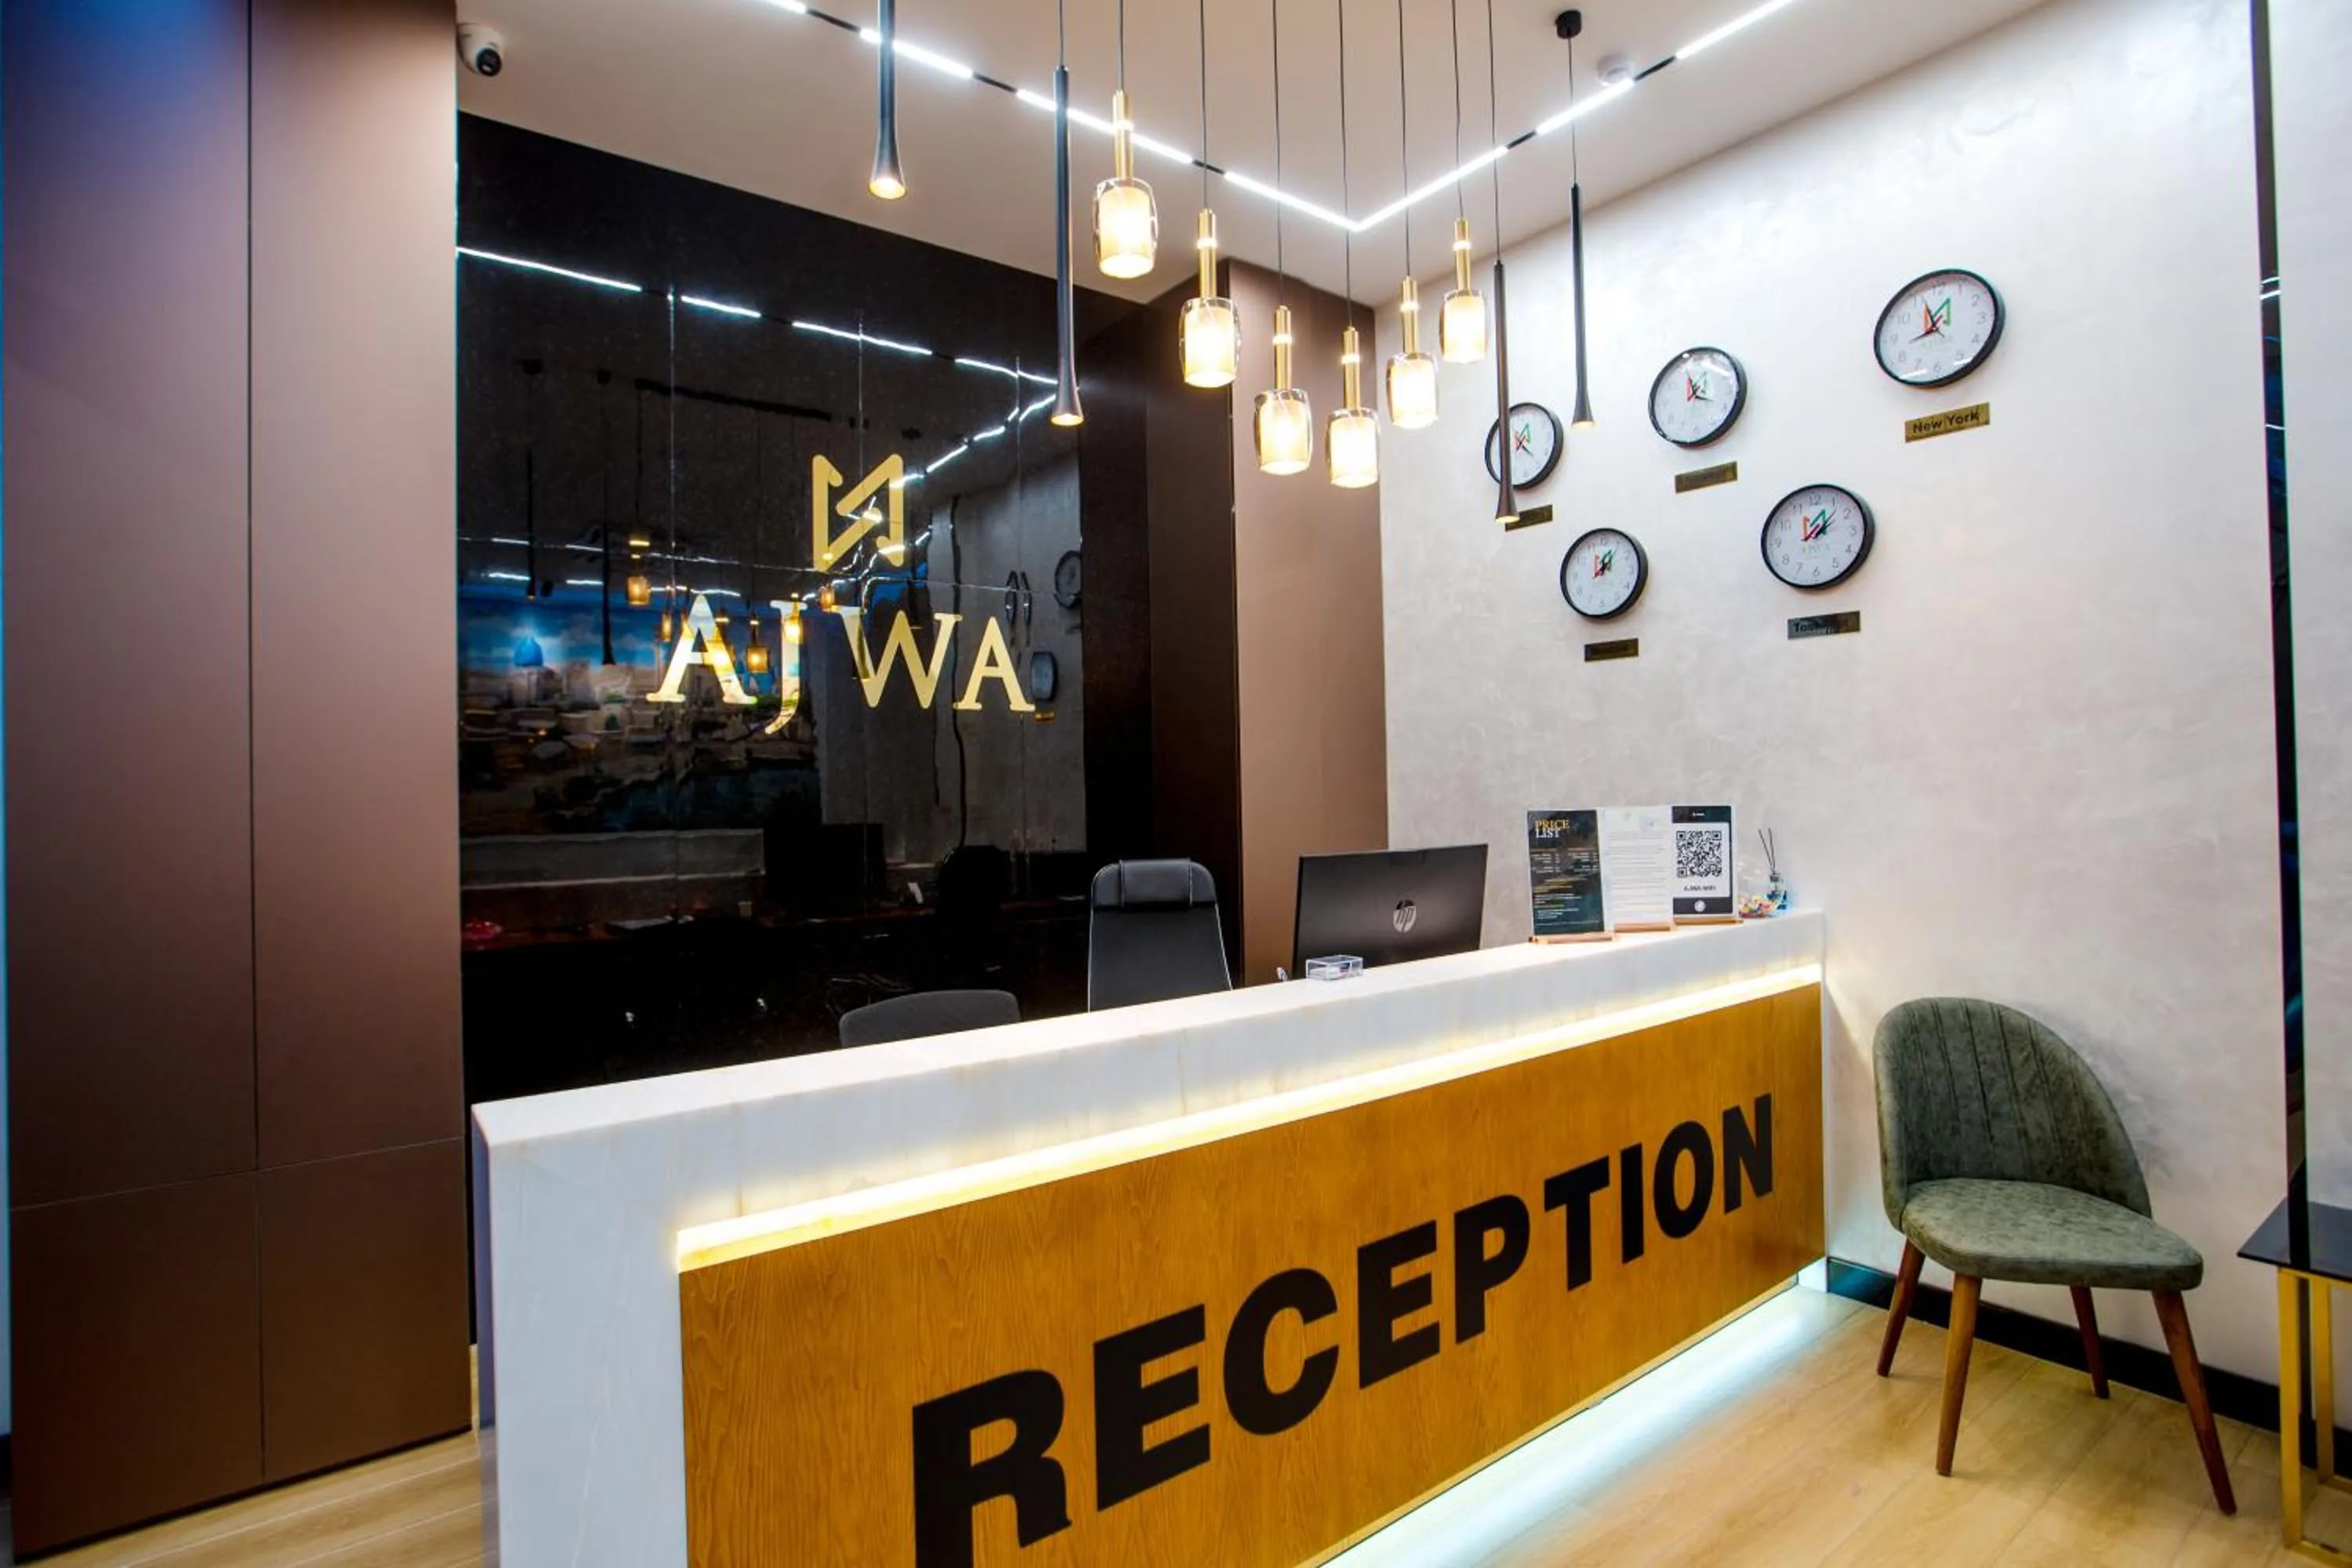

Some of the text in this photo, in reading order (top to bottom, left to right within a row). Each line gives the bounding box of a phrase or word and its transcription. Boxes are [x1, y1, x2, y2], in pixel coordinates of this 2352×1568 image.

[1971, 293, 1981, 307] 2
[1976, 311, 1987, 325] 3
[1913, 408, 1980, 434] New York
[1849, 524, 1857, 536] 3
[1781, 553, 1790, 565] 8
[1812, 565, 1820, 577] 6
[646, 593, 1035, 735] AJWA
[1534, 818, 1570, 829] PRICE
[1535, 827, 1561, 839] LIST
[1392, 899, 1417, 934] hp
[912, 1093, 1773, 1568] RECEPTION
